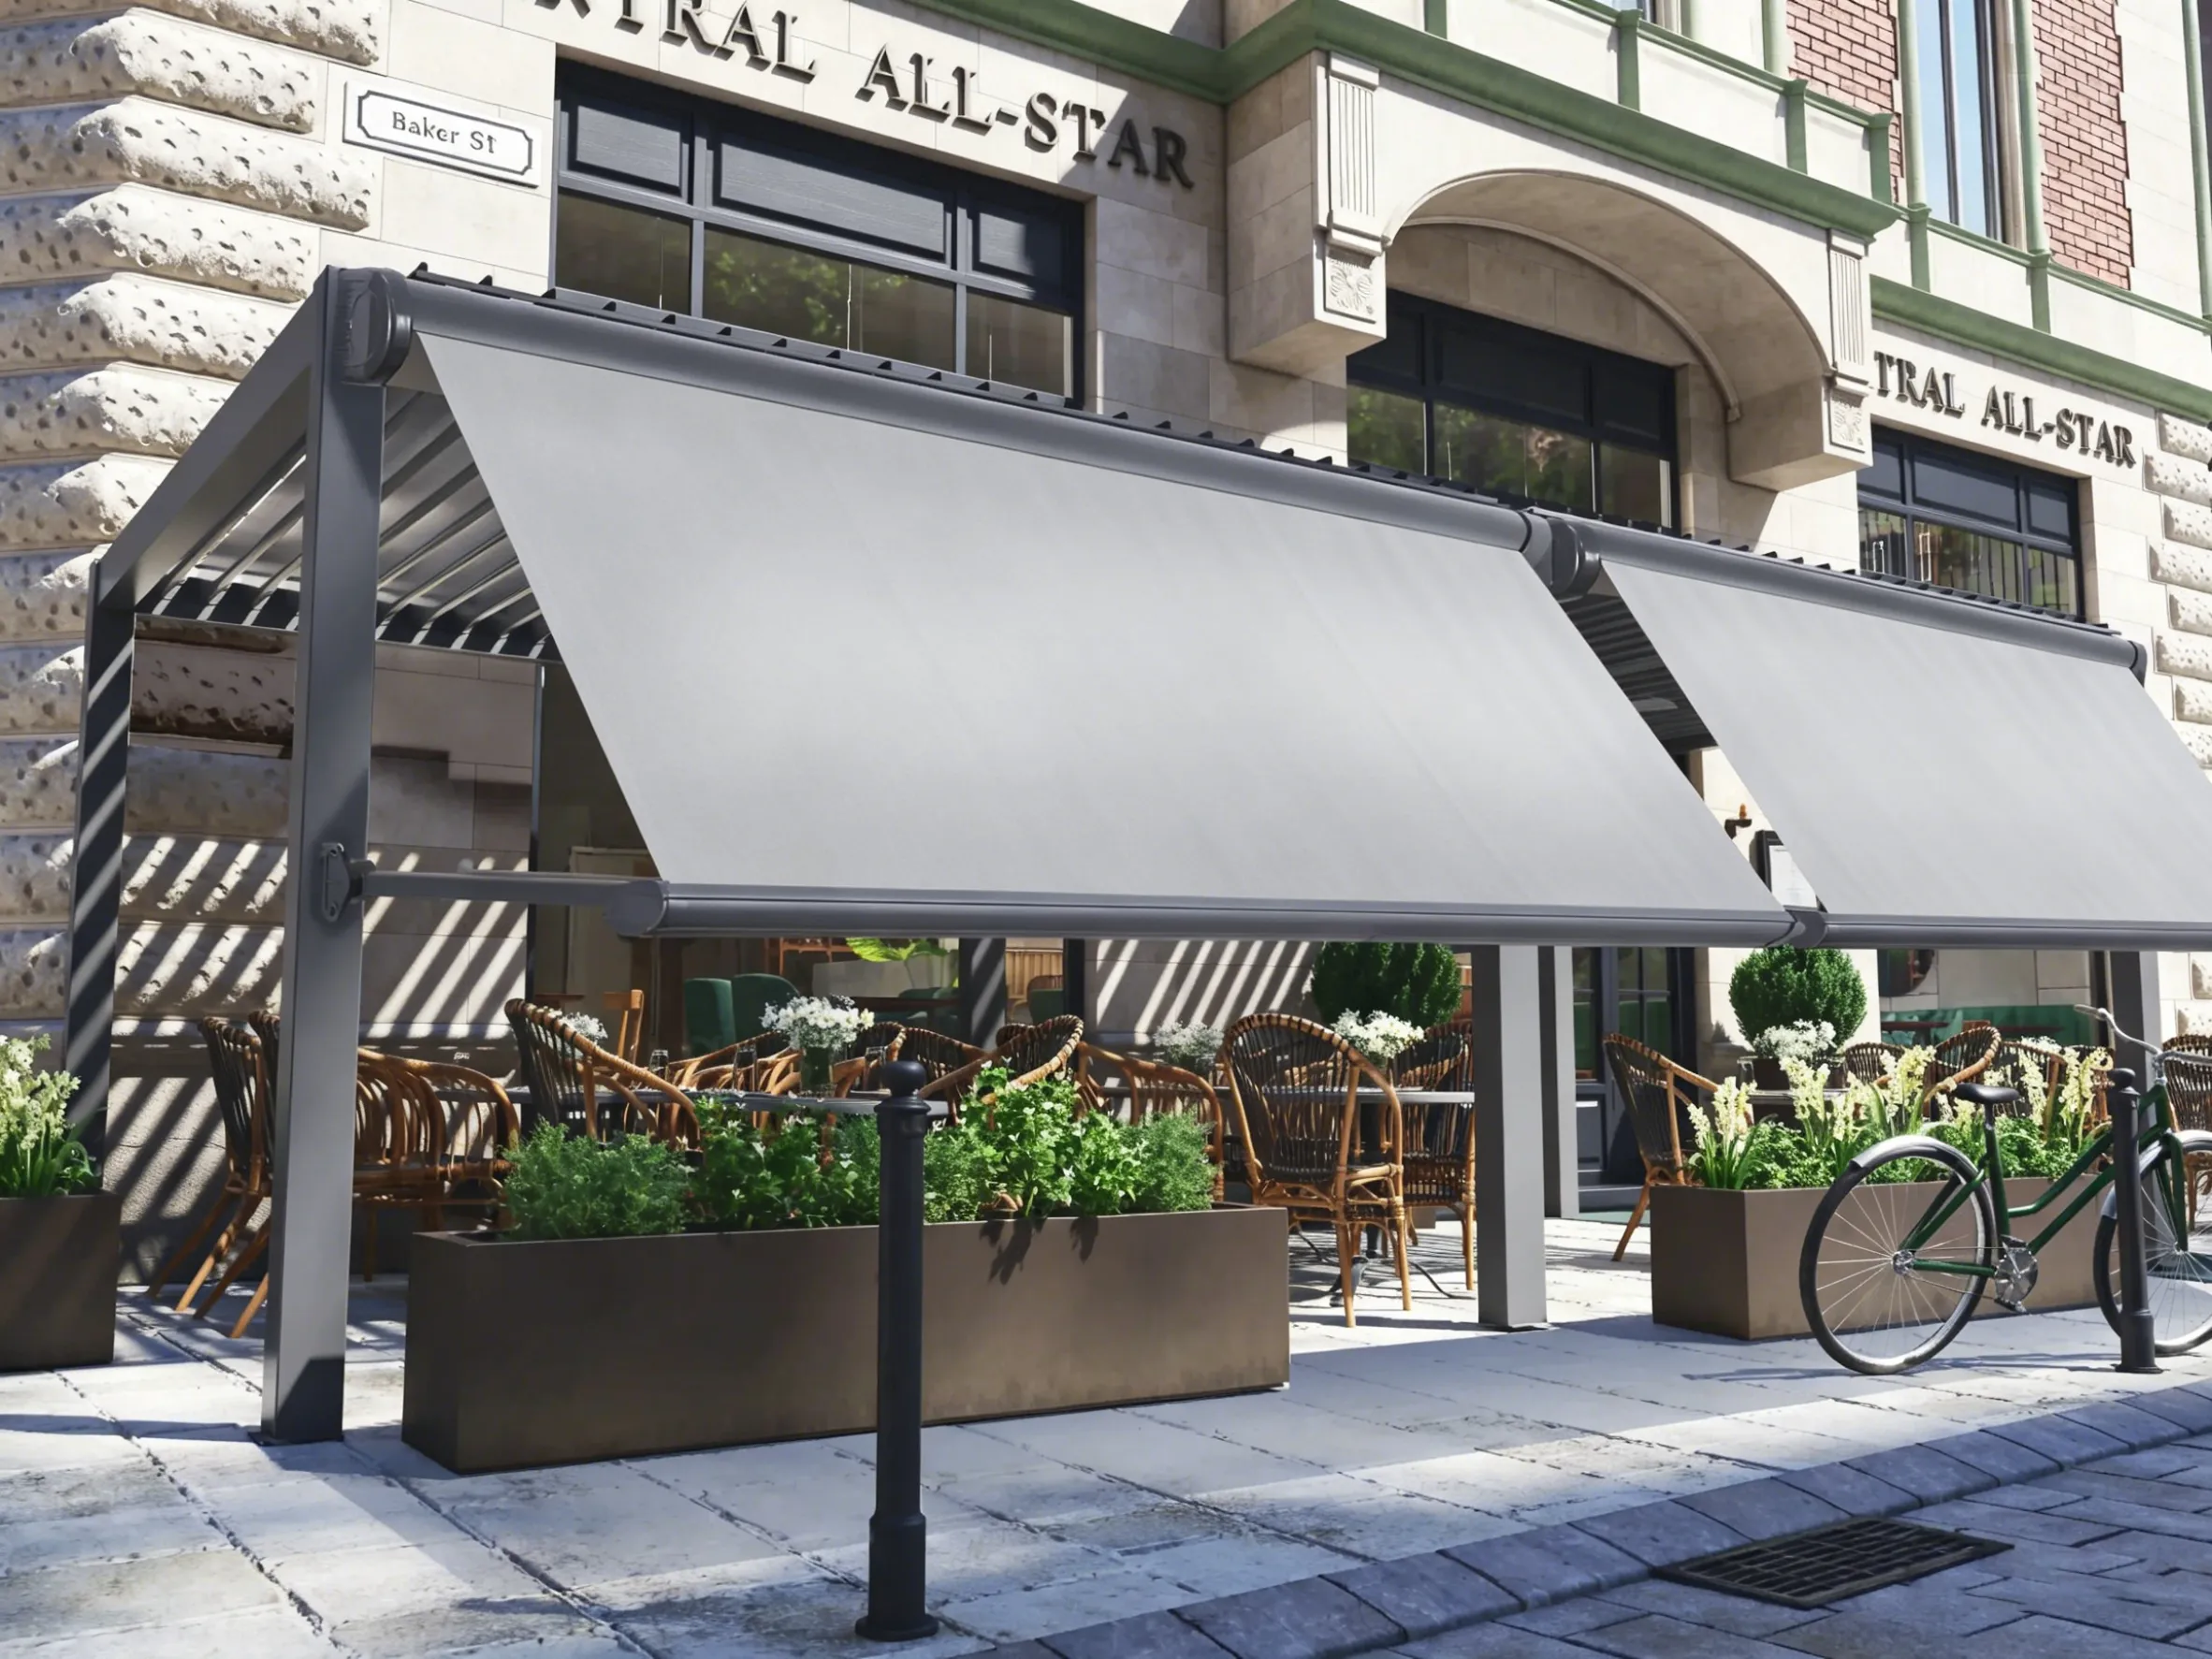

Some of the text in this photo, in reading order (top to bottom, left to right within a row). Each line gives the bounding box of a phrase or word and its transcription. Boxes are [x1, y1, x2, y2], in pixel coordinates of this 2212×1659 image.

[392, 110, 497, 153] Baker St
[534, 0, 1194, 190] RAL ALL-STAR
[1873, 350, 2136, 469] TRAL ALL-STAR
